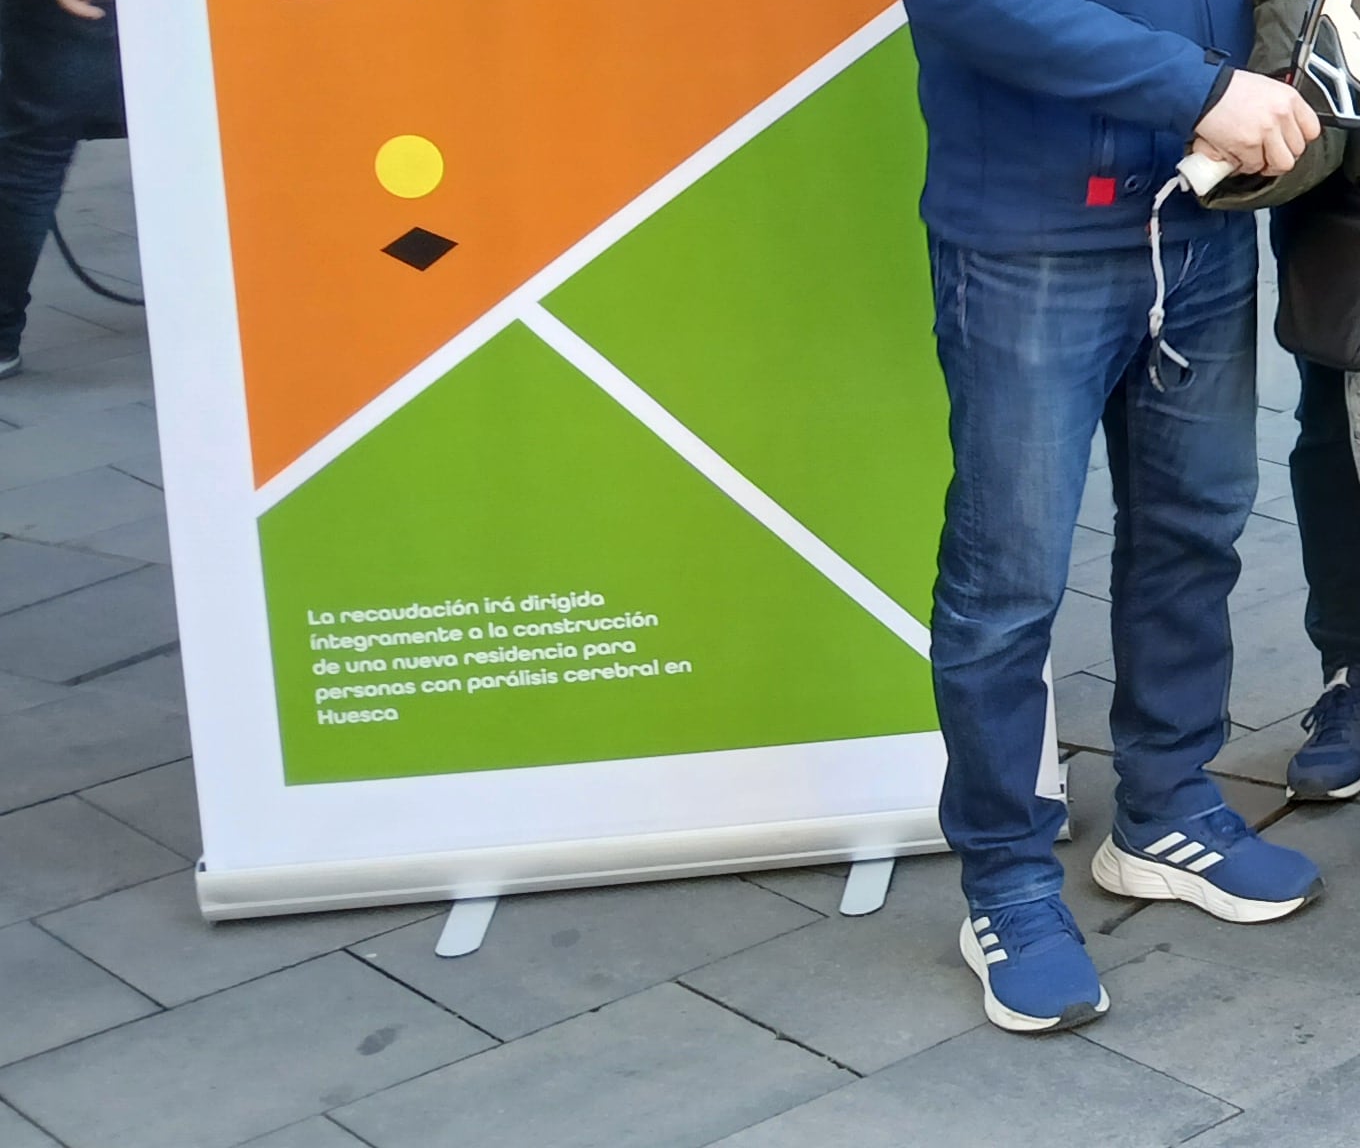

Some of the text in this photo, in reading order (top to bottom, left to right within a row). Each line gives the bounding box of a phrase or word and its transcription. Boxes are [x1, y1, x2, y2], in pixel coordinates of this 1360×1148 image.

[308, 590, 605, 626] La recaudación irá dirigida
[468, 625, 483, 640] a
[488, 622, 509, 639] la
[513, 611, 659, 638] construcción
[312, 638, 636, 676] de una nueva residencia para
[315, 658, 692, 704] personas con parálisis cerebral en
[317, 705, 399, 725] Huesca
